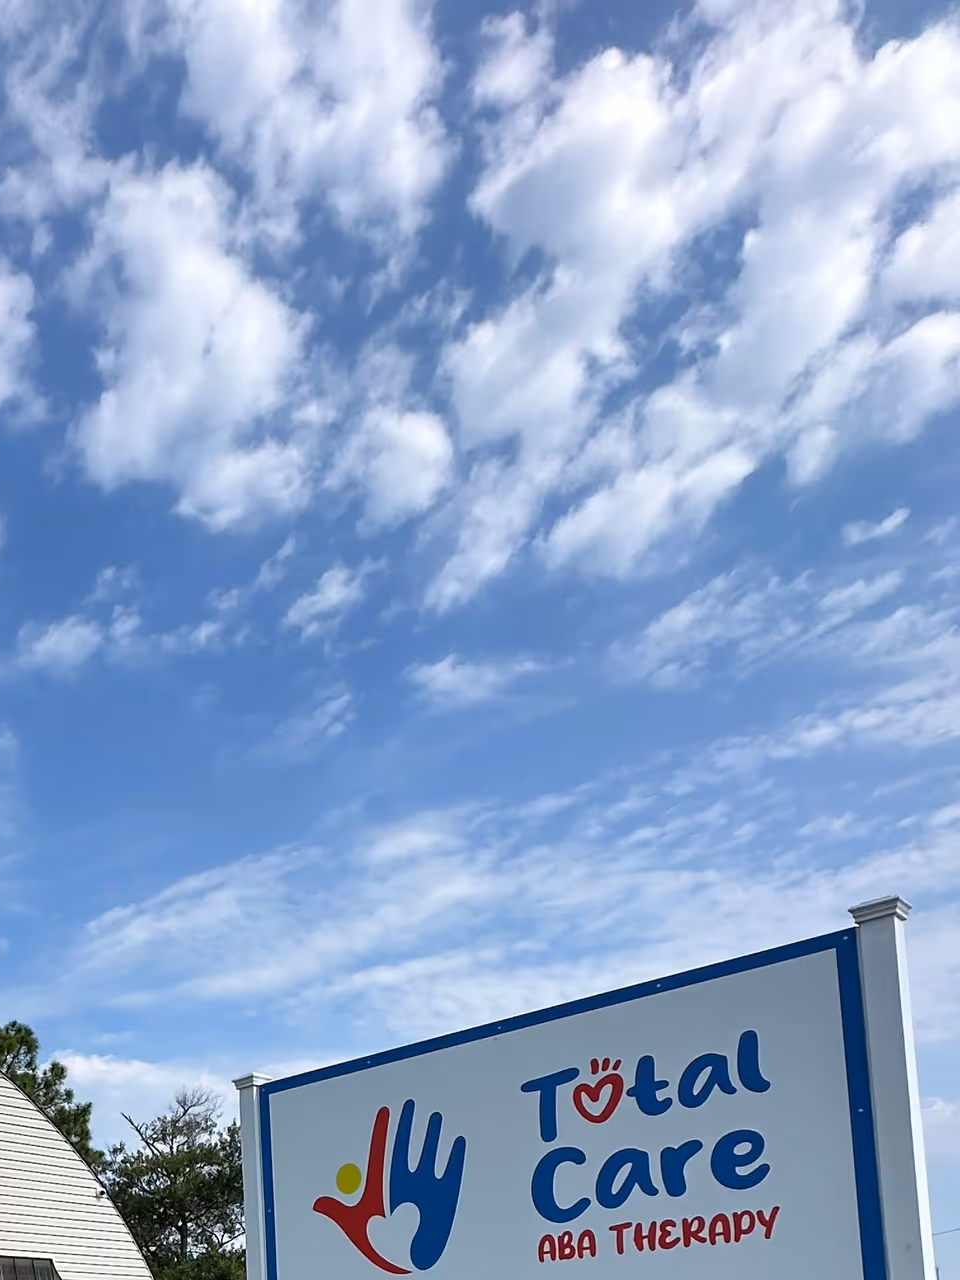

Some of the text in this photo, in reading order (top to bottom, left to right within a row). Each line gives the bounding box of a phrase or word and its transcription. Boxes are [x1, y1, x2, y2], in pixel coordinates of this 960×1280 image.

[520, 1029, 771, 1143] Total
[531, 1129, 771, 1224] Care
[538, 1206, 780, 1263] ABA THERAPY
